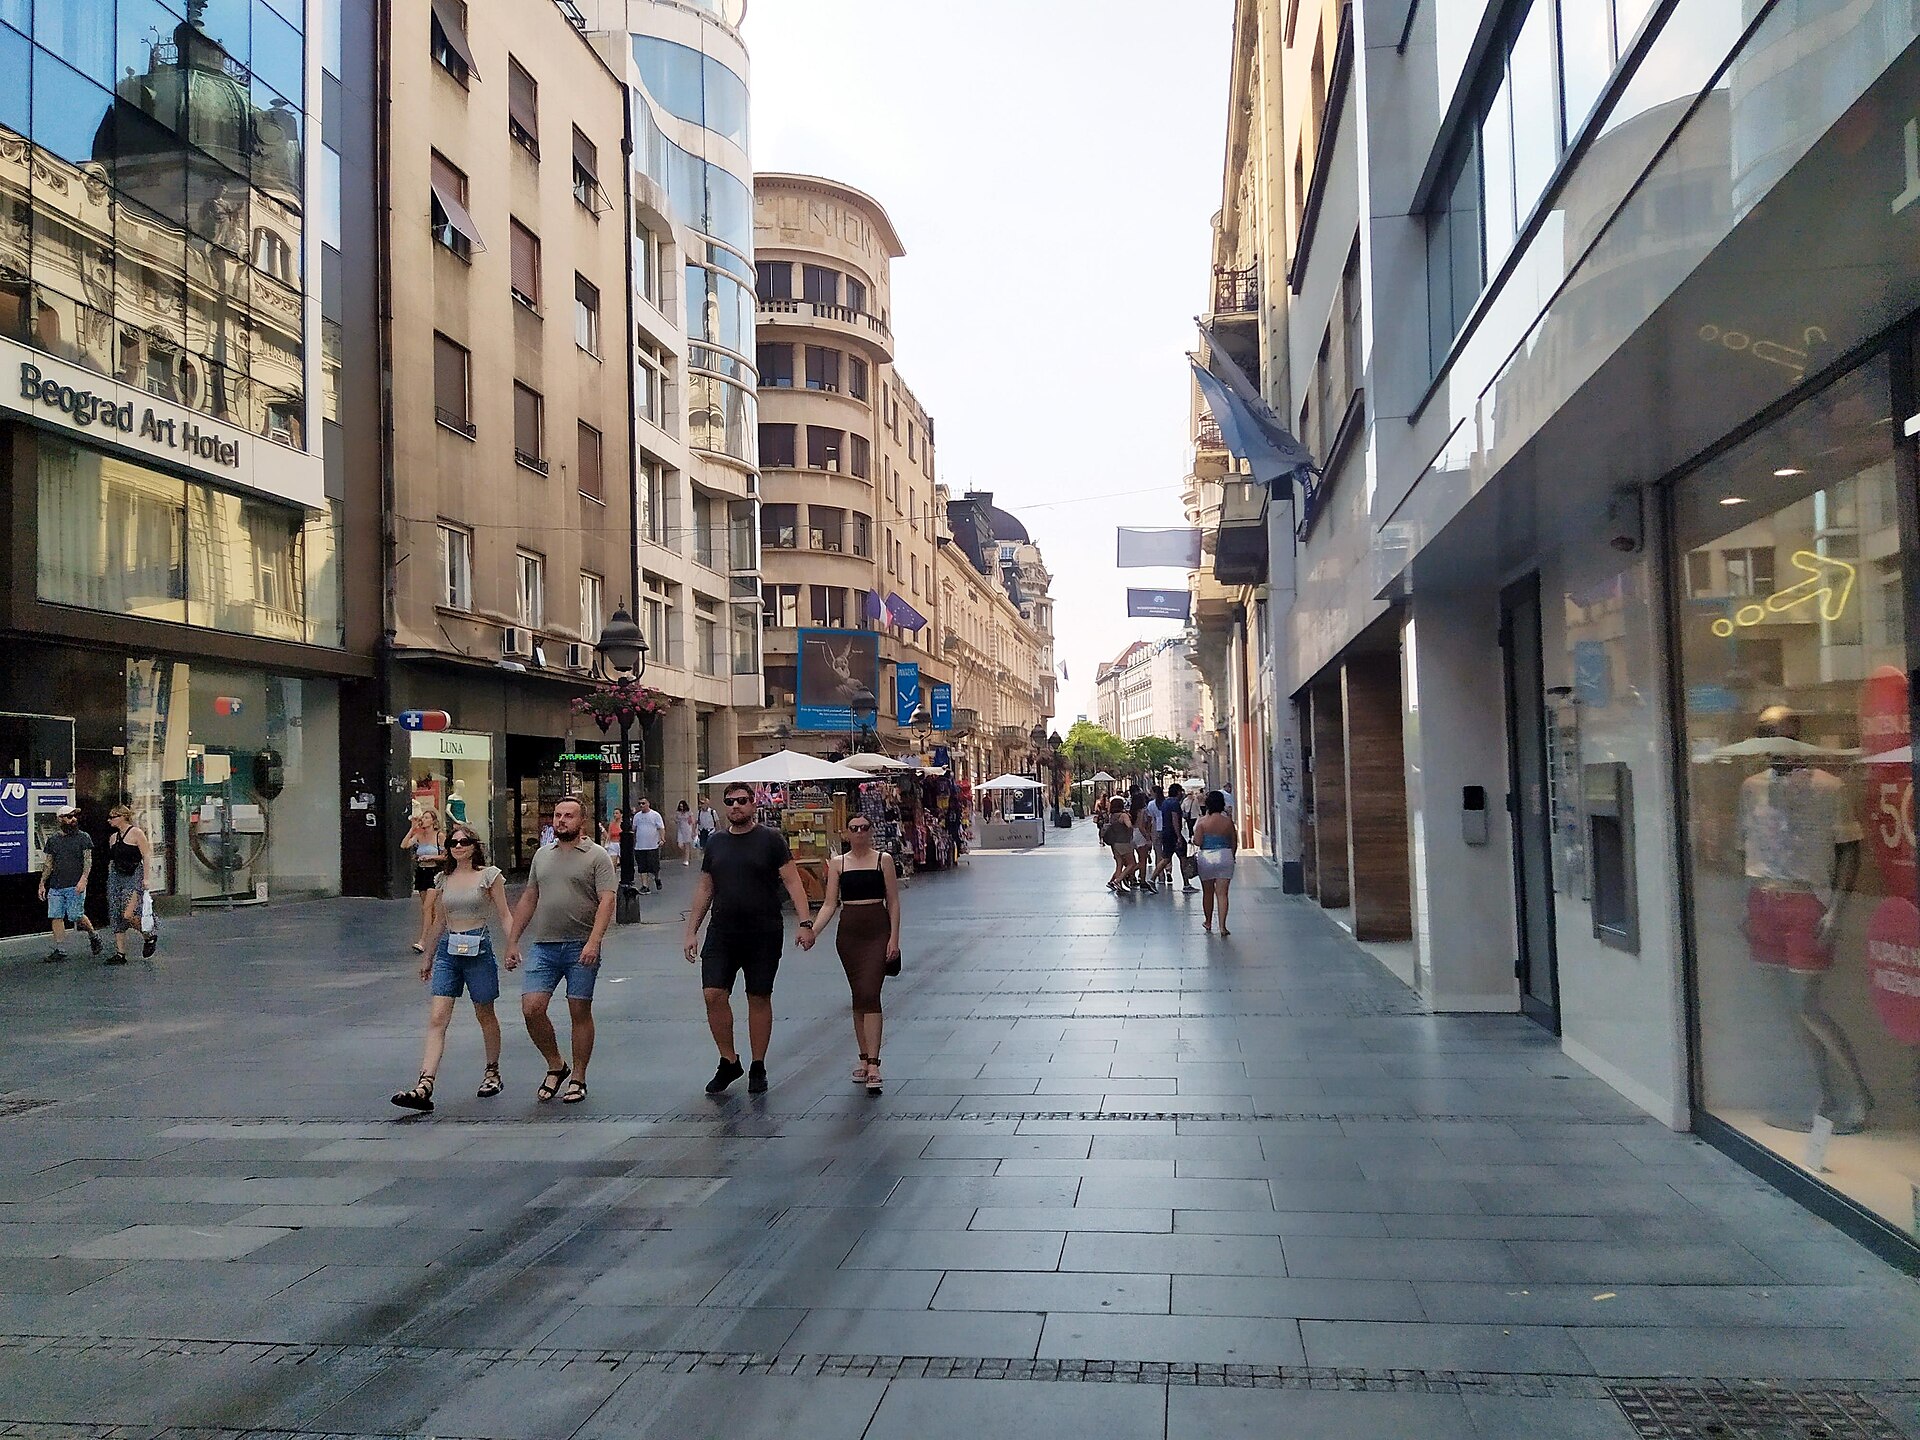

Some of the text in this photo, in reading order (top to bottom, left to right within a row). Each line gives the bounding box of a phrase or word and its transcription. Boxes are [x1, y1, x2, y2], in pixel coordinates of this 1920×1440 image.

[20, 362, 240, 468] Beograd Art Hotel
[600, 744, 639, 754] STF
